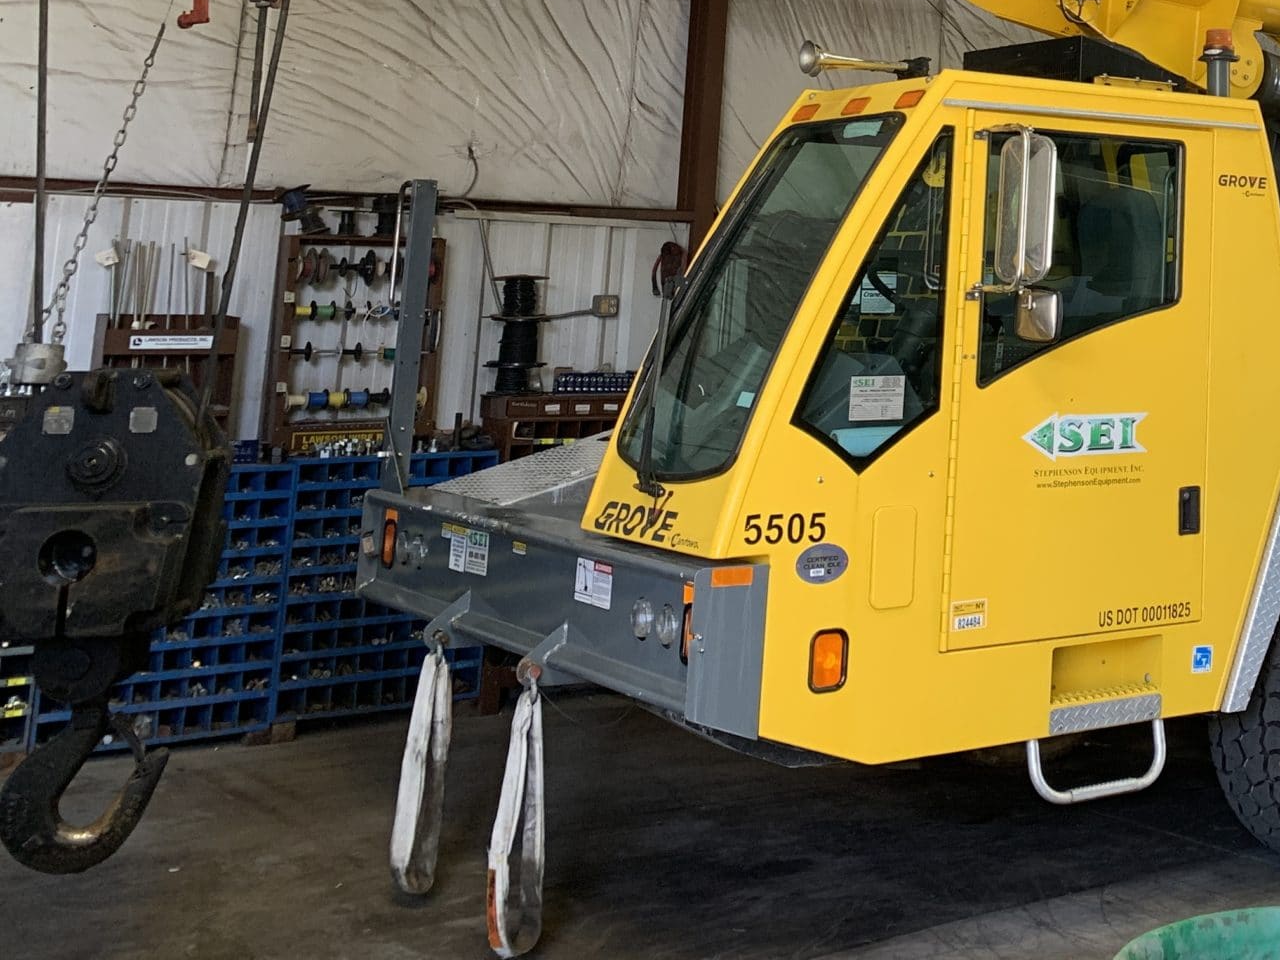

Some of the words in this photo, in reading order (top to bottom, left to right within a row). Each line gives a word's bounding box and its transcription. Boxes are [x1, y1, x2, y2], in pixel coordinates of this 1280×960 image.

[1218, 174, 1267, 189] GROVE
[302, 433, 345, 444] LAWSON
[1058, 417, 1136, 453] SEI
[1033, 468, 1083, 478] STEPHENSON
[1036, 477, 1141, 489] www.StephensonEquipment.com
[594, 500, 679, 543] GROVE
[744, 512, 826, 545] 5505
[806, 555, 839, 563] CERTIFIED
[1098, 610, 1113, 628] US
[1116, 607, 1139, 626] DOT
[1142, 601, 1191, 623] 00011825
